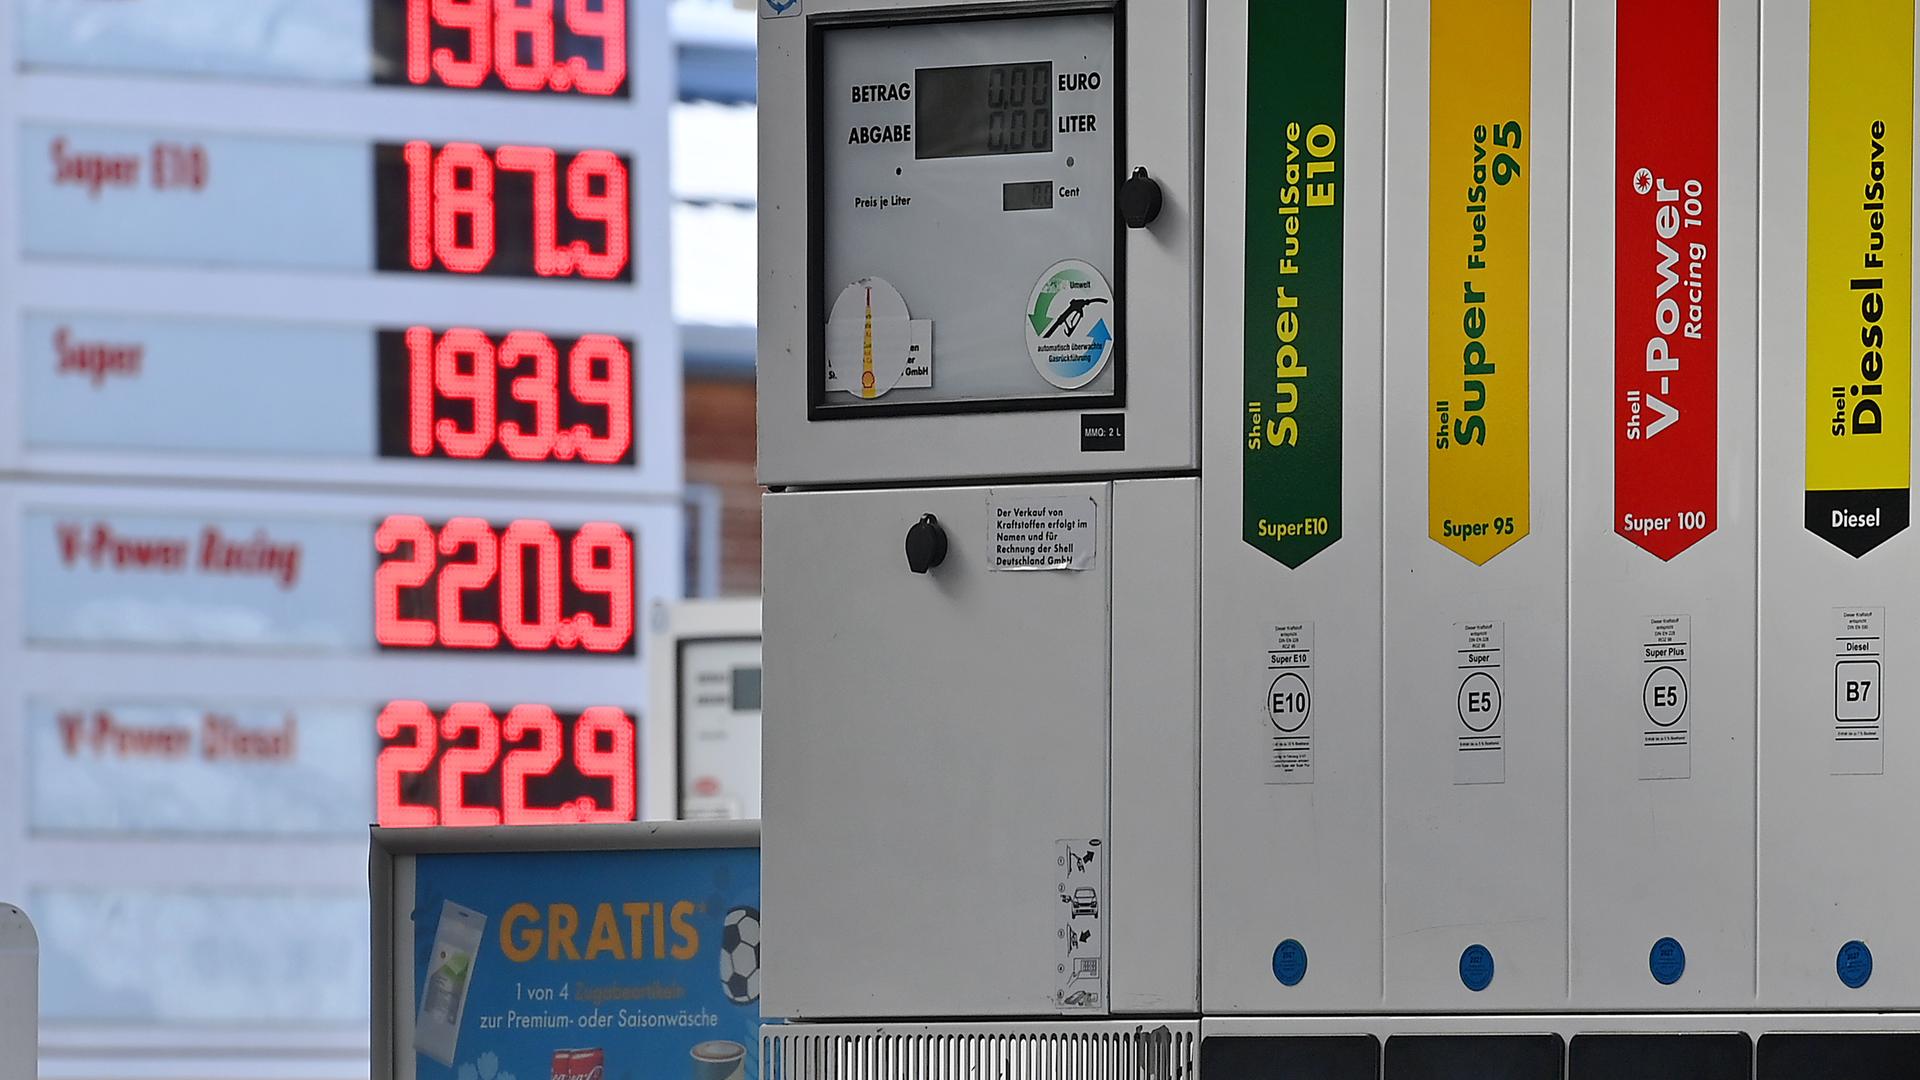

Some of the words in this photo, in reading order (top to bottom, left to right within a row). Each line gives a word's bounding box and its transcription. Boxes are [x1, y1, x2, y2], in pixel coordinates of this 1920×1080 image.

[405, 0, 628, 95] 198.9
[851, 83, 911, 103] BETRAG
[1058, 72, 1101, 91] EURO
[848, 124, 911, 144] ABGABE
[1058, 115, 1097, 133] LITER
[1306, 123, 1336, 207] E10
[1492, 120, 1522, 187] 95
[50, 136, 139, 199] Super
[151, 141, 210, 192] E10
[855, 196, 878, 208] Preis
[880, 195, 889, 210] je
[891, 194, 911, 206] Liter
[1058, 186, 1080, 198] Cent
[1278, 121, 1300, 274] FuelSave
[1467, 124, 1487, 270] FuelSave
[1684, 179, 1704, 229] 100
[1863, 119, 1886, 268] FuelSave
[403, 140, 629, 280] 187.9
[1683, 242, 1707, 339] Racing
[1646, 177, 1681, 440] V-Power
[53, 325, 145, 389] Super
[1267, 286, 1307, 447] Super
[1454, 281, 1496, 446] Super
[1850, 277, 1884, 435] Diesel
[405, 326, 633, 464] 193.9
[1627, 390, 1640, 440] Shell
[1832, 386, 1846, 438] Shell
[1109, 427, 1114, 436] 2
[1116, 427, 1121, 436] L
[1249, 401, 1261, 451] Shell
[1436, 400, 1449, 450] Shell
[997, 508, 1011, 517] Der
[1014, 507, 1046, 517] Verkauf
[997, 520, 1045, 529] Kraftstoffen
[1048, 519, 1075, 530] erfolgt
[1077, 520, 1088, 528] im
[1624, 514, 1672, 536] Super
[1677, 511, 1706, 531] 100
[1831, 508, 1880, 528] Diesel
[996, 533, 1026, 541] Namen
[1028, 532, 1043, 541] und
[1045, 532, 1058, 540] für
[1443, 520, 1489, 539] Super
[1493, 517, 1514, 535] 95
[55, 521, 190, 574] V-Power
[198, 523, 304, 592] Racing
[996, 544, 1035, 555] Rechnung
[1037, 543, 1051, 553] der
[1054, 543, 1074, 553] Shell
[996, 556, 1045, 565] Deutschland
[374, 514, 635, 652] 220.9
[1271, 654, 1293, 664] Super
[1294, 653, 1307, 663] E10
[1468, 654, 1490, 664] Super
[1645, 648, 1667, 658] Super
[1668, 647, 1685, 656] Plus
[1846, 642, 1869, 651] Diesel
[1273, 692, 1306, 713] E10
[1468, 692, 1491, 712] E5
[1654, 686, 1678, 706] E5
[1846, 681, 1872, 702] B7
[56, 709, 192, 761] V-Power
[200, 709, 298, 765] Diesel
[376, 700, 637, 826] 222.9
[515, 982, 522, 1000] 1
[527, 986, 554, 1001] von
[559, 982, 570, 1000] 4
[479, 1014, 503, 1030] zur
[507, 1009, 574, 1029] Premium-
[578, 1006, 615, 1028] oder
[619, 1005, 718, 1028] Saisonwäsche
